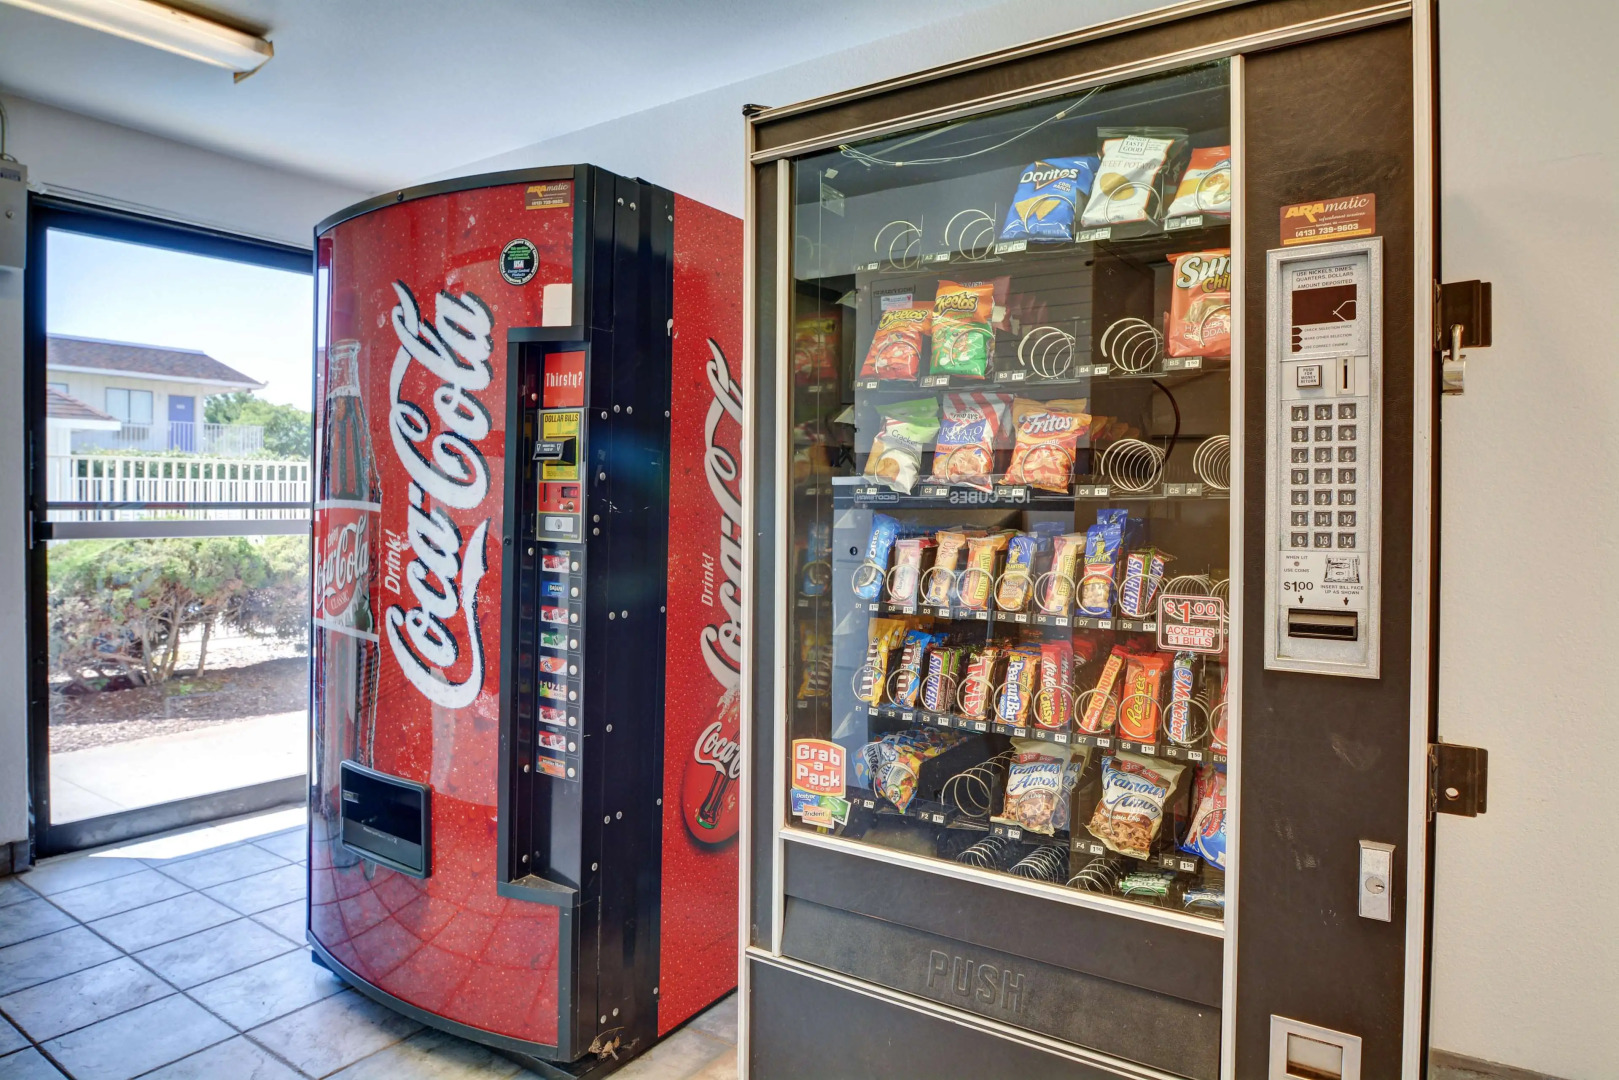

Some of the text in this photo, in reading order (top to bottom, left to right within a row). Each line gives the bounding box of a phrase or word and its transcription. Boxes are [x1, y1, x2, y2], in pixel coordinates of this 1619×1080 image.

[1102, 160, 1122, 168] WEET
[1020, 169, 1078, 183] Doritos
[1295, 229, 1316, 238] (413)
[1318, 223, 1359, 234] 739-9603
[878, 309, 929, 330] Cheetos
[546, 371, 583, 388] Thirsty?
[544, 414, 578, 423] DOLLAR BILLS
[1024, 413, 1073, 434] Fritos
[386, 278, 495, 709] Coca-Cola
[869, 530, 880, 559] OREO
[384, 529, 400, 594] Drink!
[701, 552, 714, 607] Drink!
[1124, 558, 1143, 615] SNICKERS
[1167, 626, 1214, 637] ACCEPTS
[1169, 636, 1212, 646] $1 BILLS
[542, 681, 564, 692] FUZE
[925, 655, 942, 711] SNICKERS
[964, 657, 987, 716] TWIX
[1006, 661, 1024, 721] Peanut Bar
[1127, 675, 1146, 727] Reese's
[1171, 682, 1190, 743] Musketeer
[796, 744, 840, 766] Grab
[796, 763, 840, 787] Pack
[813, 761, 824, 772] a
[1010, 763, 1060, 776] Famous
[1010, 774, 1058, 792] Amos
[1103, 773, 1166, 798] Famous
[1106, 793, 1158, 813] Amos
[1163, 858, 1173, 866] F5
[927, 950, 1025, 1013] PUSH
